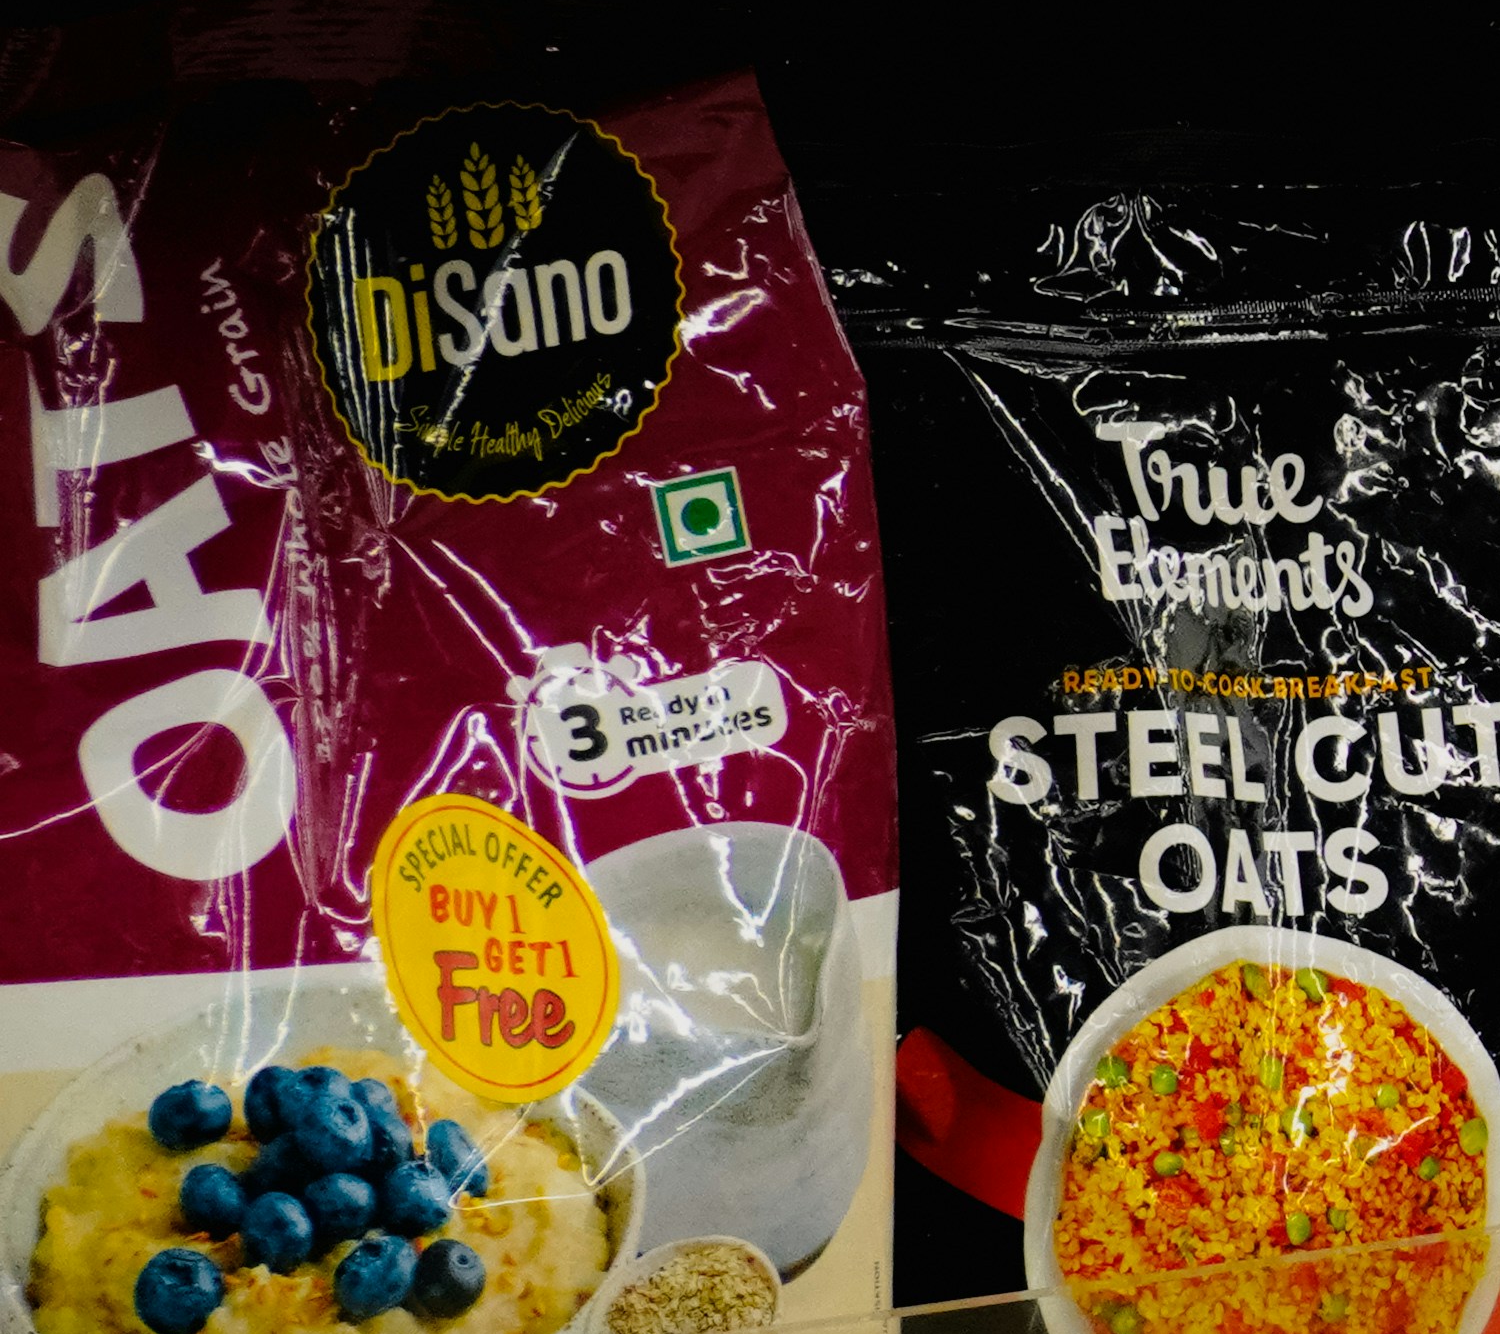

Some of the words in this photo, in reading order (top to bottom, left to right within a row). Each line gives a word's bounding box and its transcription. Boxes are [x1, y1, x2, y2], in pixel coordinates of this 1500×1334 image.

[354, 248, 634, 382] DiSano
[1095, 421, 1324, 526] True
[1093, 514, 1376, 619] Elements
[559, 703, 609, 764] 3
[987, 710, 1268, 806] STEEL
[400, 822, 478, 893] SPECIAL
[483, 831, 565, 909] OFFER
[428, 885, 496, 927] BUY
[507, 894, 528, 935] 1
[1138, 823, 1390, 918] OATS
[433, 949, 576, 1050] Free
[483, 938, 553, 976] GET
[559, 942, 581, 979] 1
